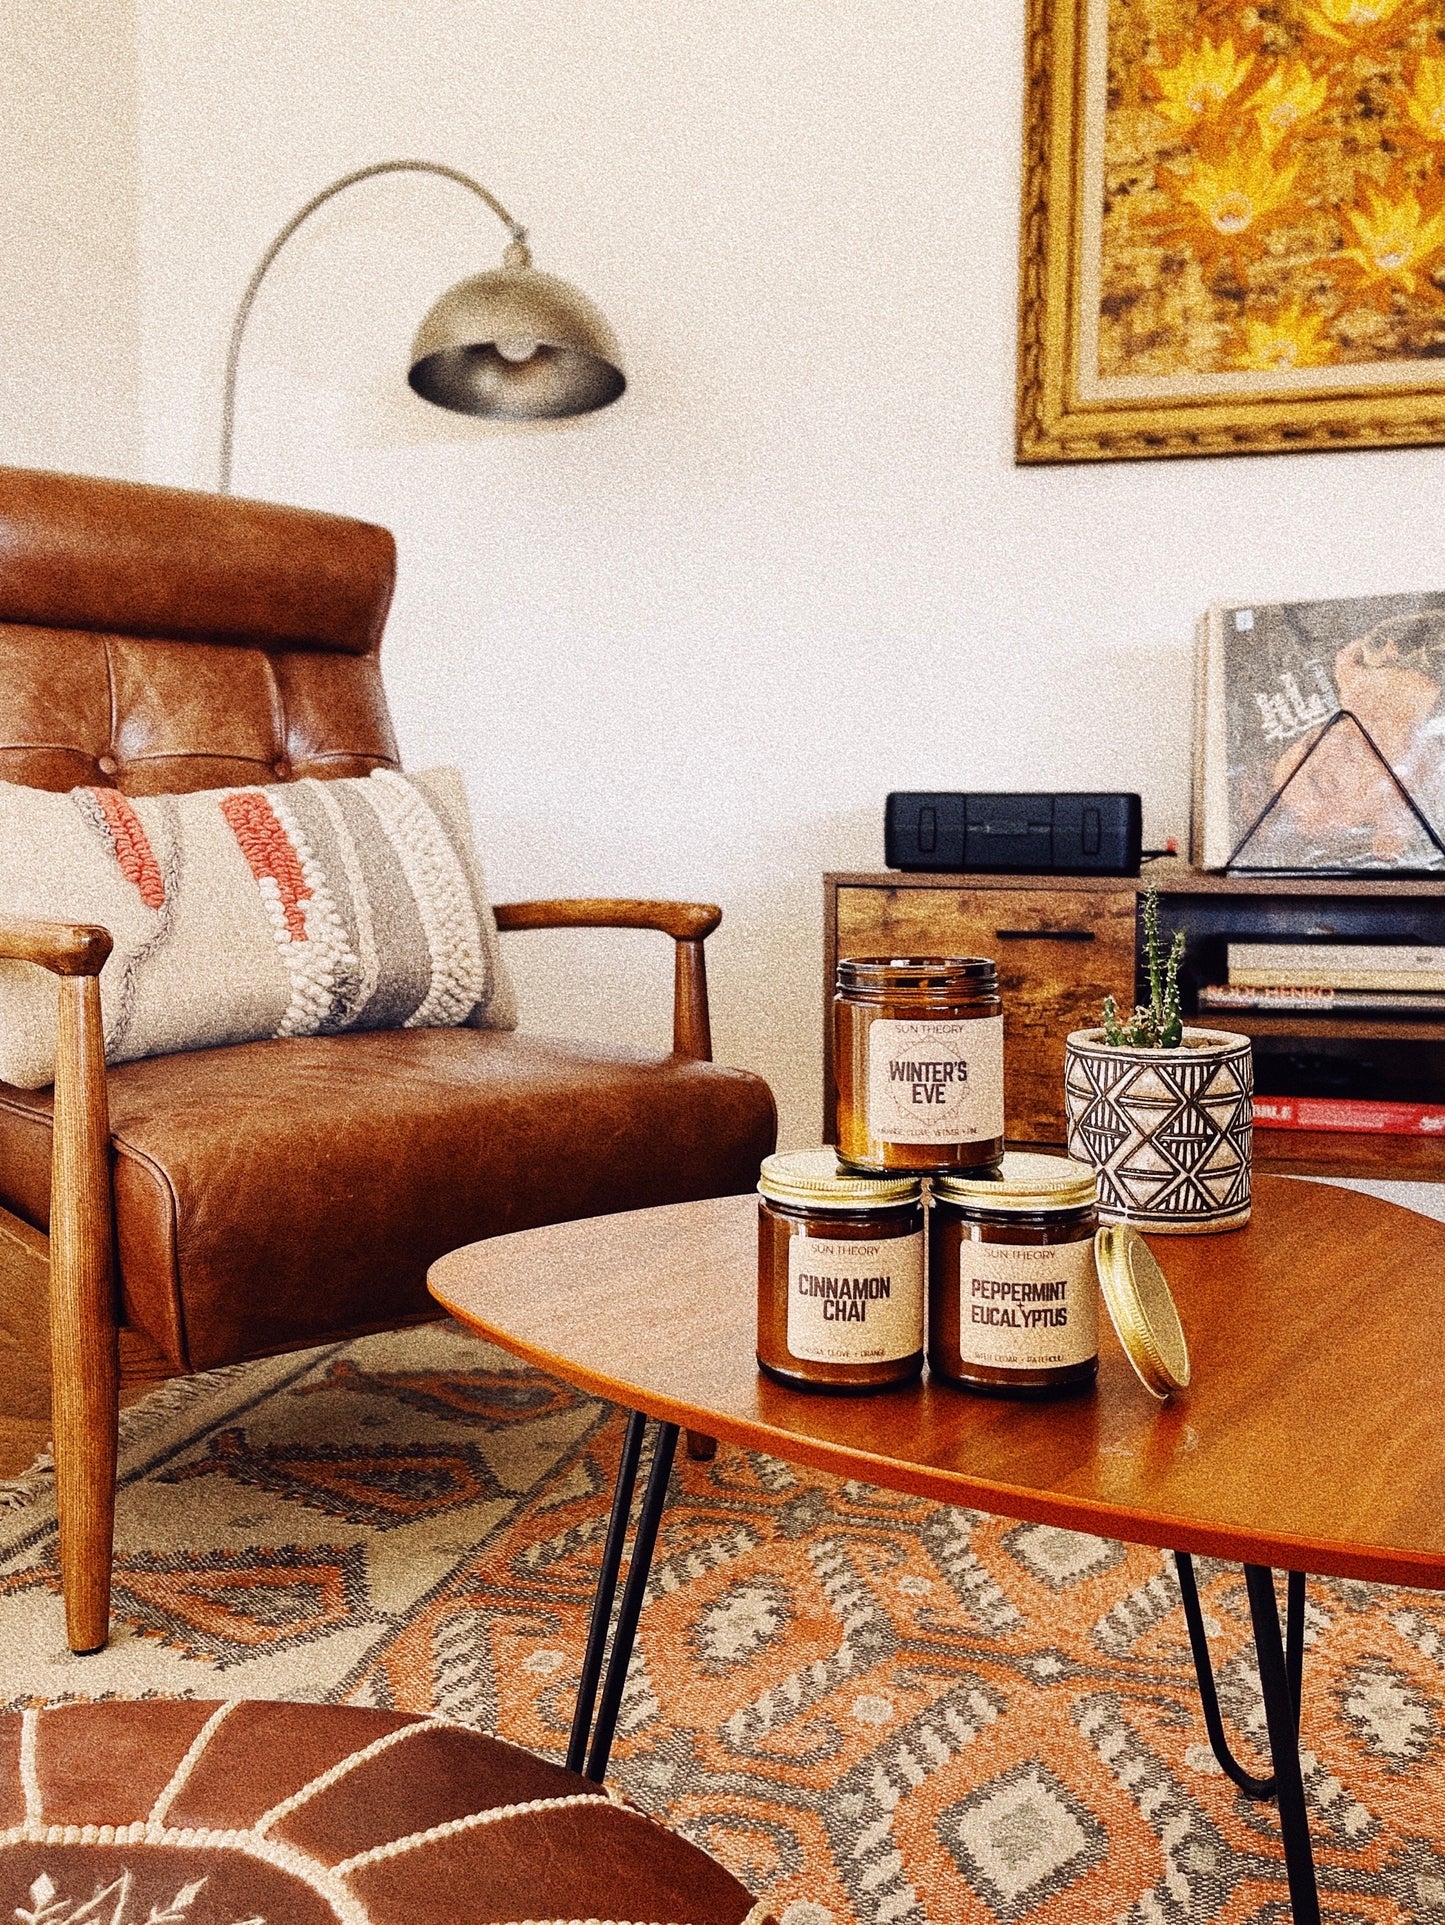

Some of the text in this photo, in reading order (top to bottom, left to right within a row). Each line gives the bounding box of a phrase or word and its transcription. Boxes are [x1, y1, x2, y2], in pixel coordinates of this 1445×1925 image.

[895, 1024, 965, 1034] SUN THEORY
[889, 1060, 968, 1082] WINTER'S
[912, 1083, 946, 1104] EVE
[811, 1244, 881, 1256] SUN THEORY
[984, 1248, 1056, 1260] SUN THEORY
[798, 1273, 891, 1300] CINNAMON
[971, 1278, 1068, 1302] PEPPERMINT
[823, 1299, 866, 1322] CHAI
[971, 1304, 1068, 1328] EUCALYPTUS
